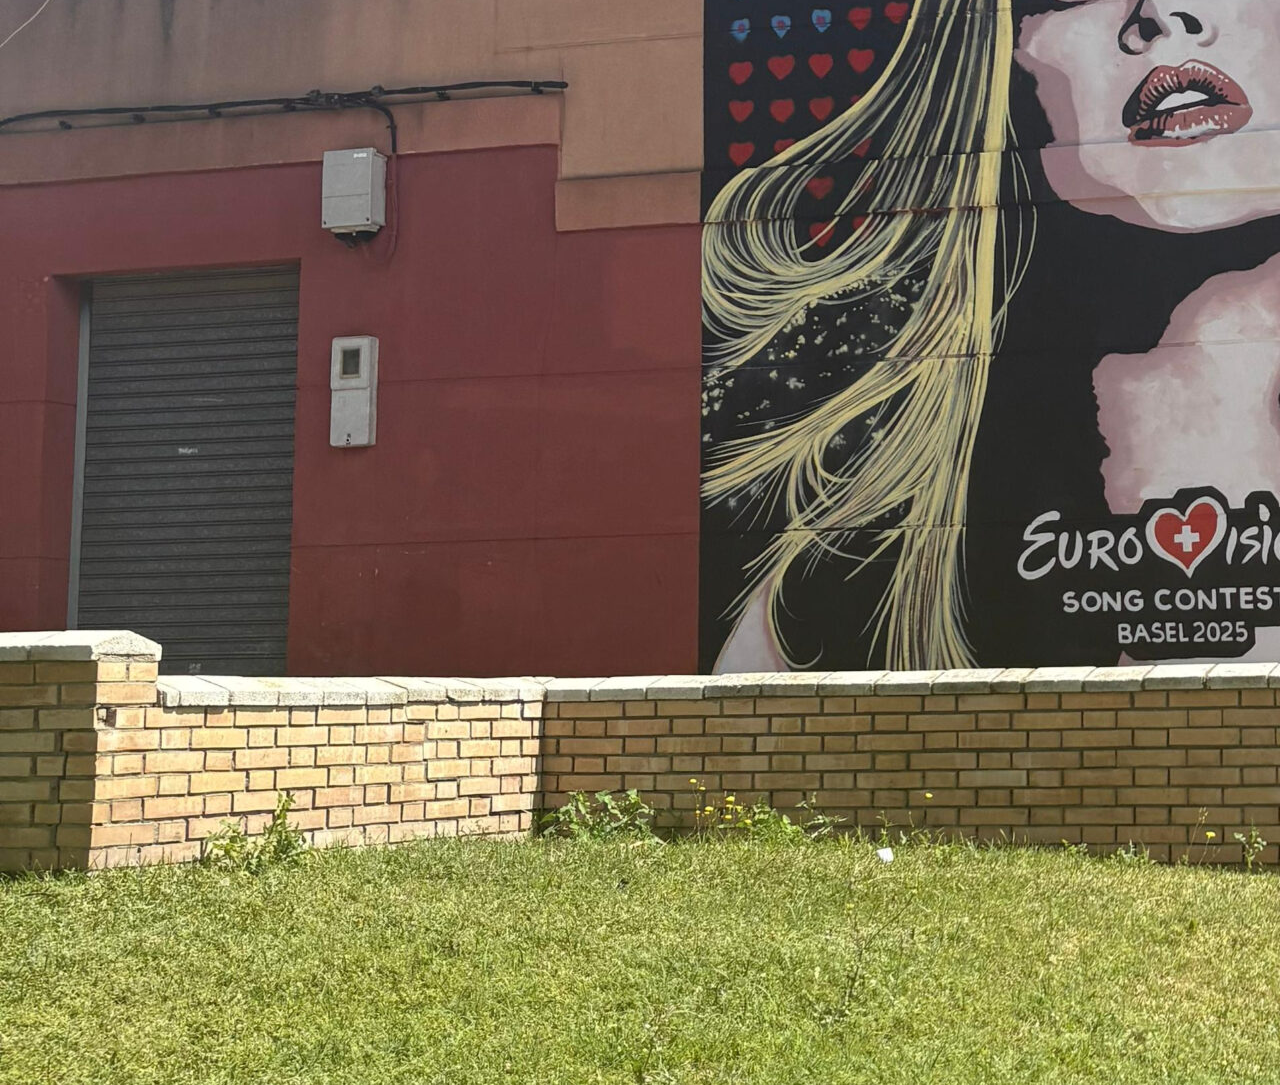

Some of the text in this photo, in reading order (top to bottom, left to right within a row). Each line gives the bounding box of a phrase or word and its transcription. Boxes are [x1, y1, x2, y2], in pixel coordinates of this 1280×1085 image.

[1062, 590, 1145, 613] SONG
[1117, 621, 1249, 644] BASEL 2025
